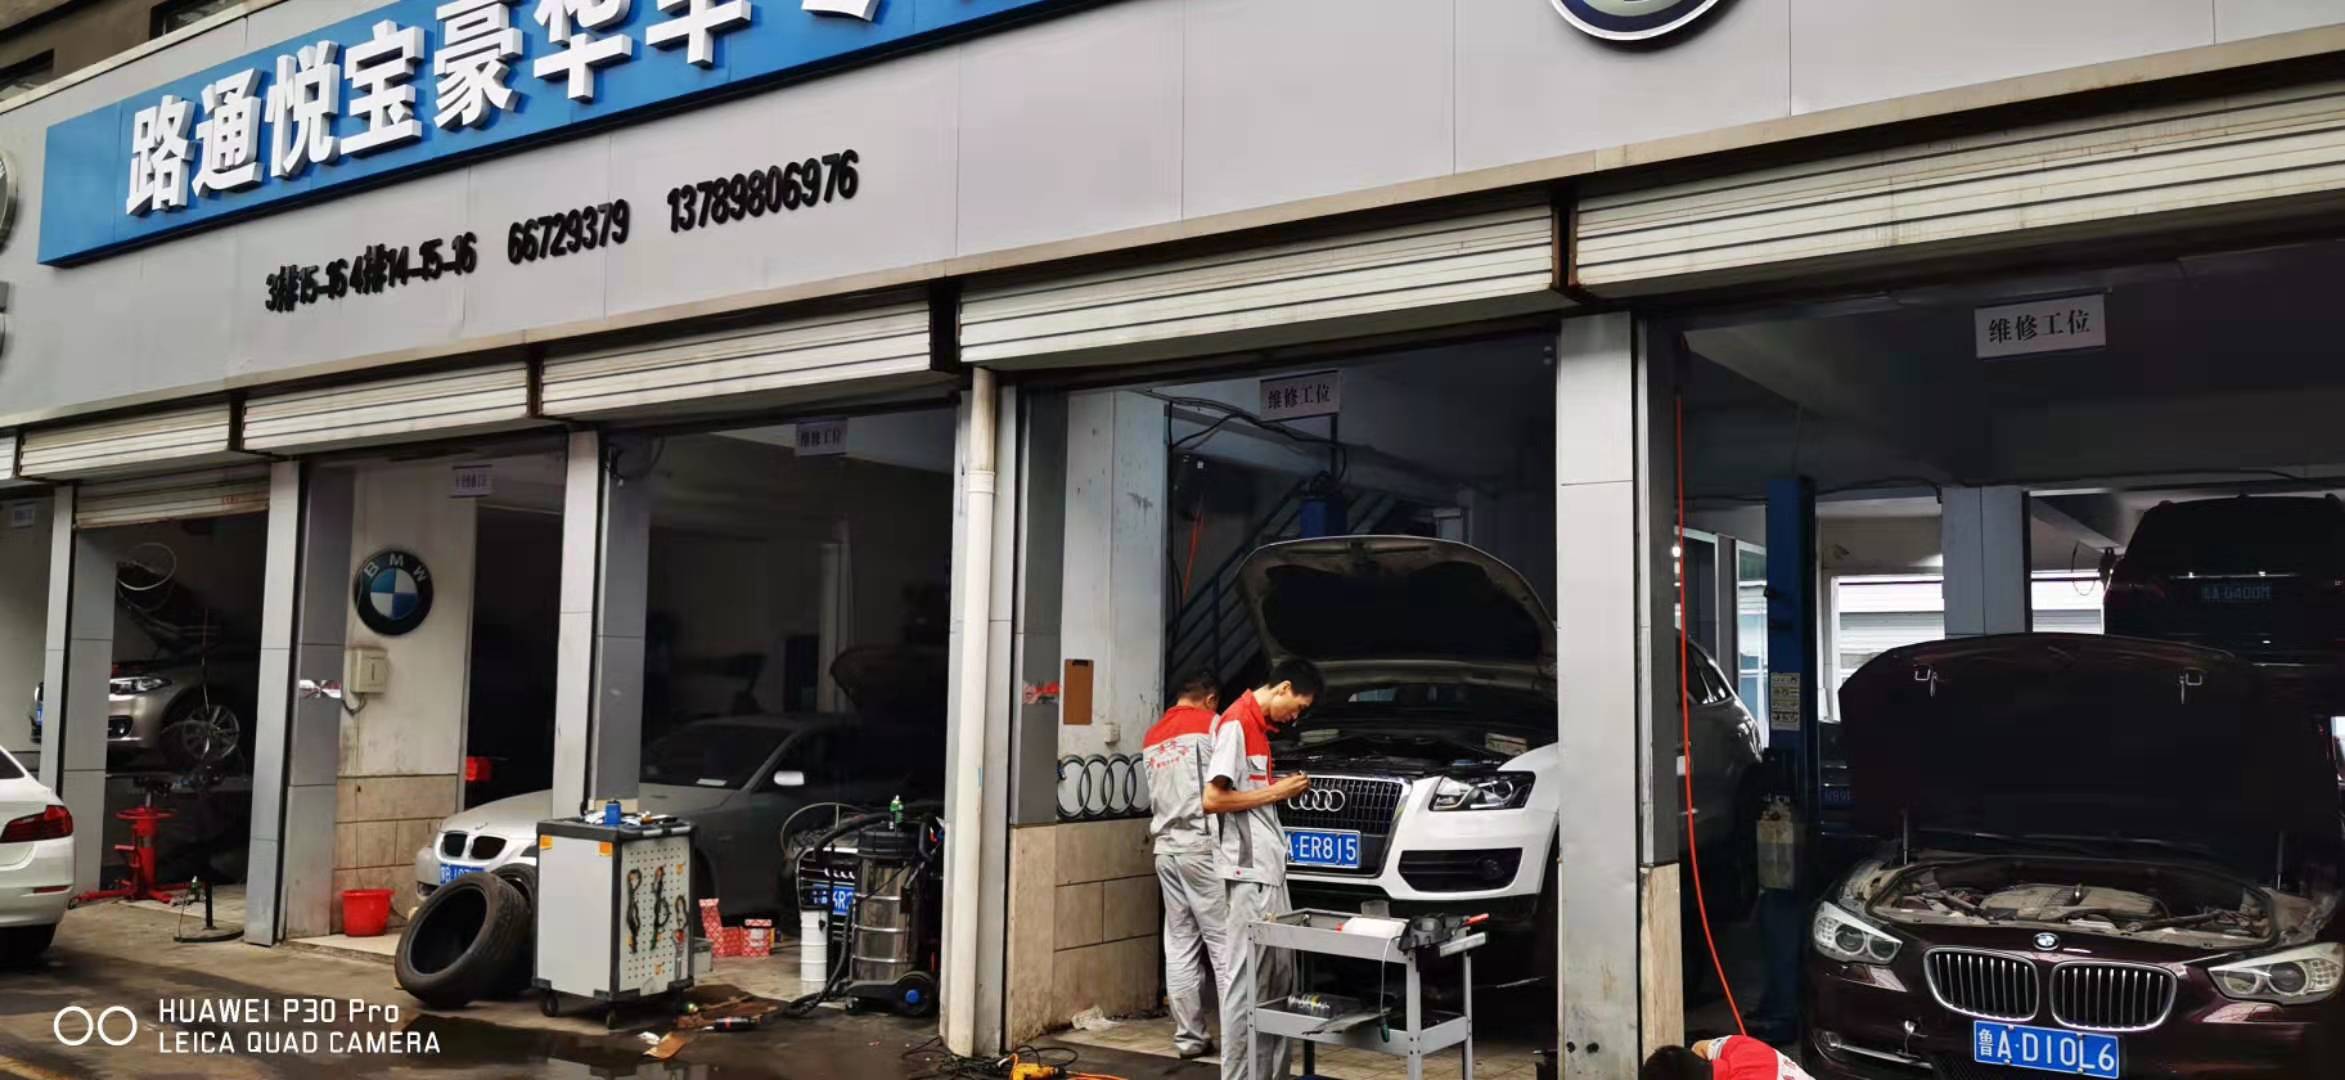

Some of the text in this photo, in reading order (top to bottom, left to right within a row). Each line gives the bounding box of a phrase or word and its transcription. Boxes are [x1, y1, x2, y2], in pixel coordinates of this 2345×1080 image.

[126, 0, 879, 216] 路通悦宝豪华
[508, 199, 630, 265] 66729379
[667, 150, 859, 233] 13789806976
[1987, 309, 2091, 344] 维修工位
[1267, 383, 1331, 409] 维修工位
[363, 553, 427, 582] BMW
